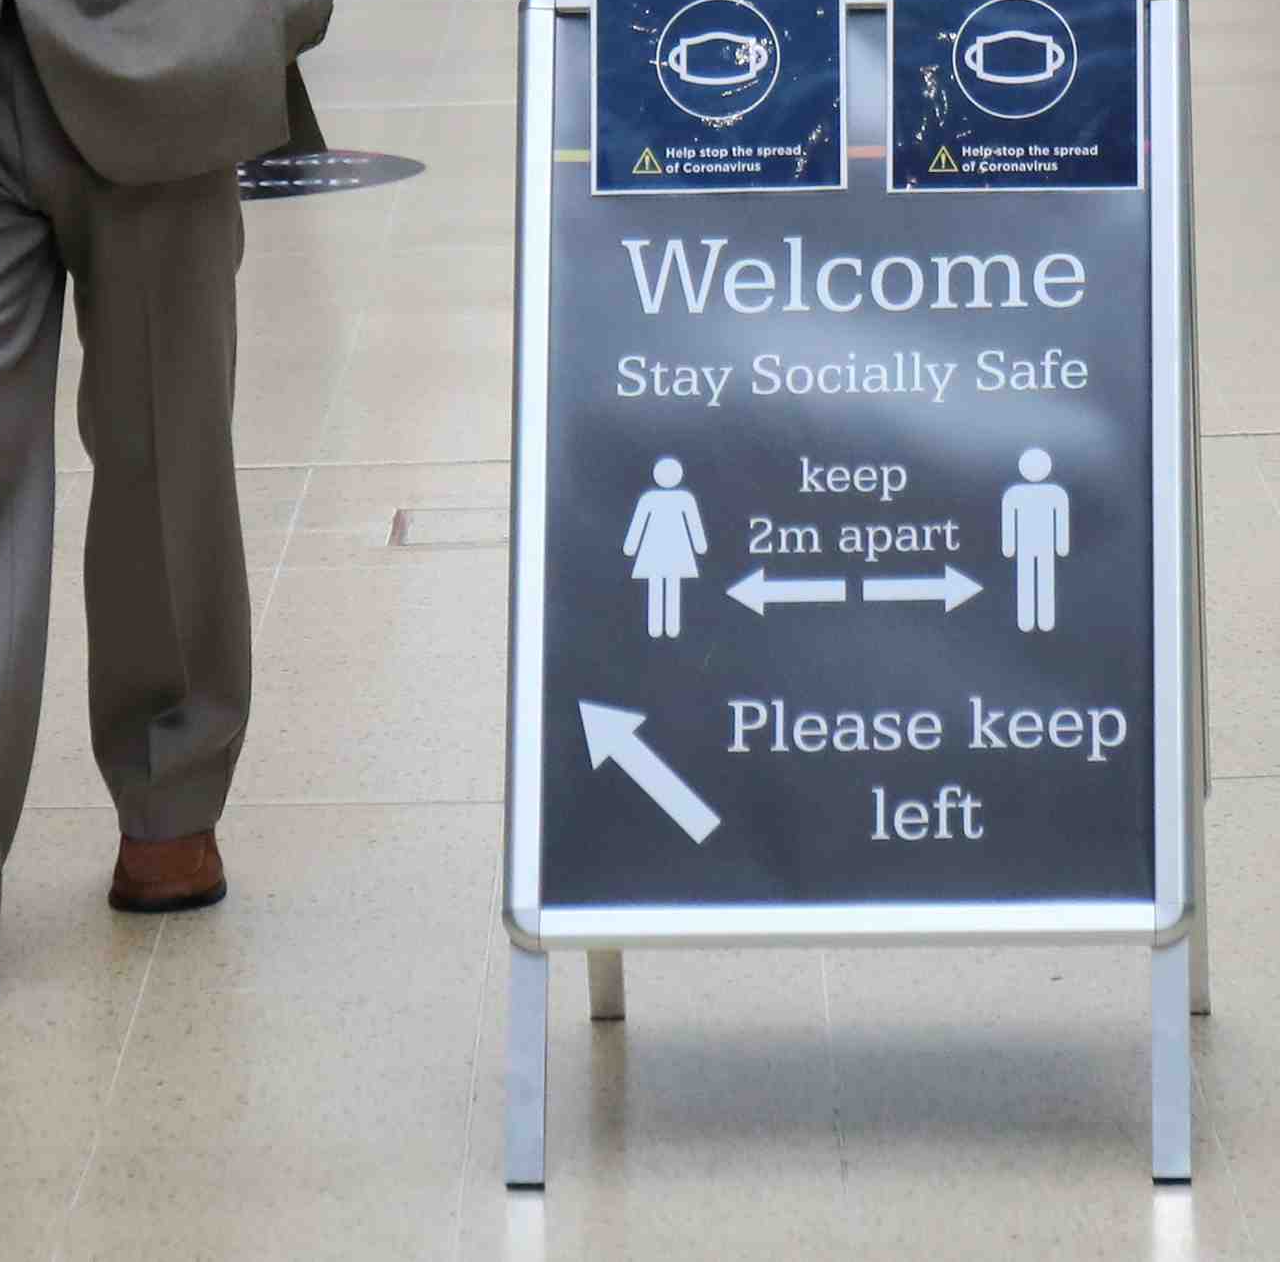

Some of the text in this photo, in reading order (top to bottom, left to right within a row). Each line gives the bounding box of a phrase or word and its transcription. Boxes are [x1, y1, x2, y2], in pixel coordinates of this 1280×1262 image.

[665, 144, 802, 159] Help stop the spread
[665, 161, 761, 174] of Coronavirus
[962, 145, 1099, 158] Help stop the spread
[962, 160, 1058, 173] of Coronavirus
[622, 237, 1086, 315] Welcome
[617, 349, 1089, 407] Stay Socially Safe
[799, 457, 907, 501] keep
[748, 517, 960, 562] 2m apart
[727, 697, 1128, 761] Please keep
[871, 786, 984, 840] left
